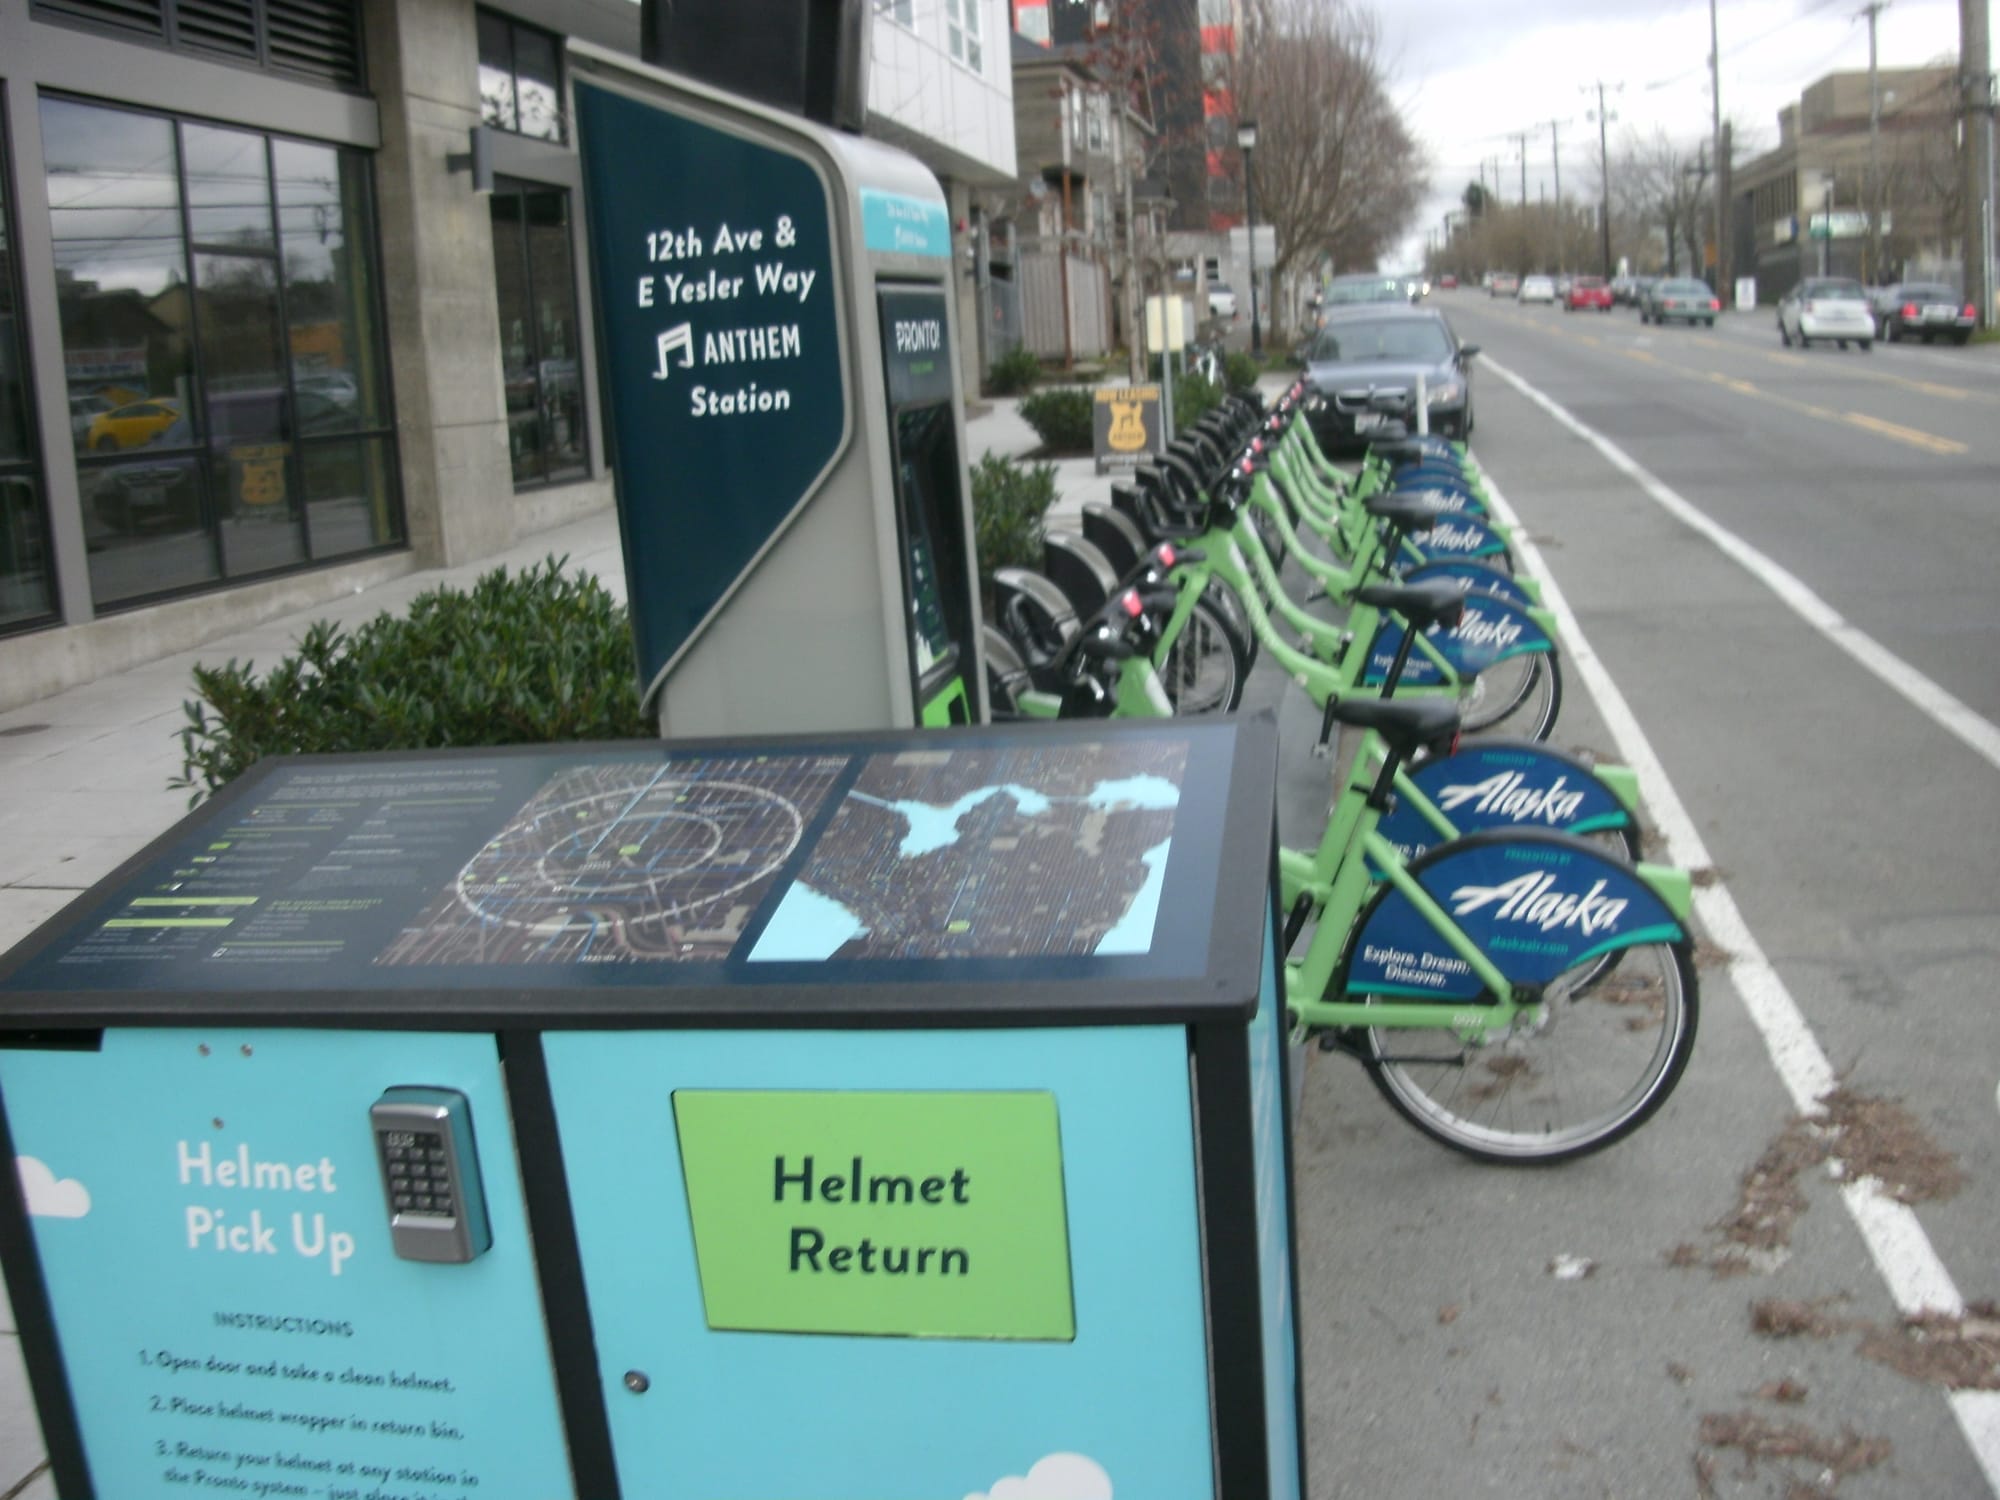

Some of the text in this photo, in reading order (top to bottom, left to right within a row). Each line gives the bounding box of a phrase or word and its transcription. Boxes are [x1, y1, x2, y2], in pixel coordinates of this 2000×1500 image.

[648, 215, 796, 262] 12th Ave &
[638, 262, 816, 307] E Yesler Way
[703, 325, 801, 365] ANTHEM
[690, 383, 791, 417] Station
[1438, 770, 1584, 824] Alaska
[1450, 870, 1628, 936] Alaska
[177, 1141, 337, 1193] Helmet
[773, 1155, 970, 1204] Helmet
[186, 1206, 355, 1276] Pick Up
[789, 1226, 970, 1275] Return
[213, 1311, 353, 1337] INSTRUCTIONS
[139, 1349, 456, 1393] 1. Open door and take a clean helmet.
[150, 1394, 464, 1440] 2. Place helmet wrapper in return bin.
[176, 1441, 231, 1461] Return
[236, 1453, 270, 1469] your
[275, 1451, 332, 1473] helmet
[337, 1460, 355, 1474] at
[360, 1463, 391, 1484] any
[395, 1466, 456, 1484] station
[461, 1469, 479, 1487] in
[194, 1468, 248, 1490] Pronto
[251, 1480, 308, 1498] system
